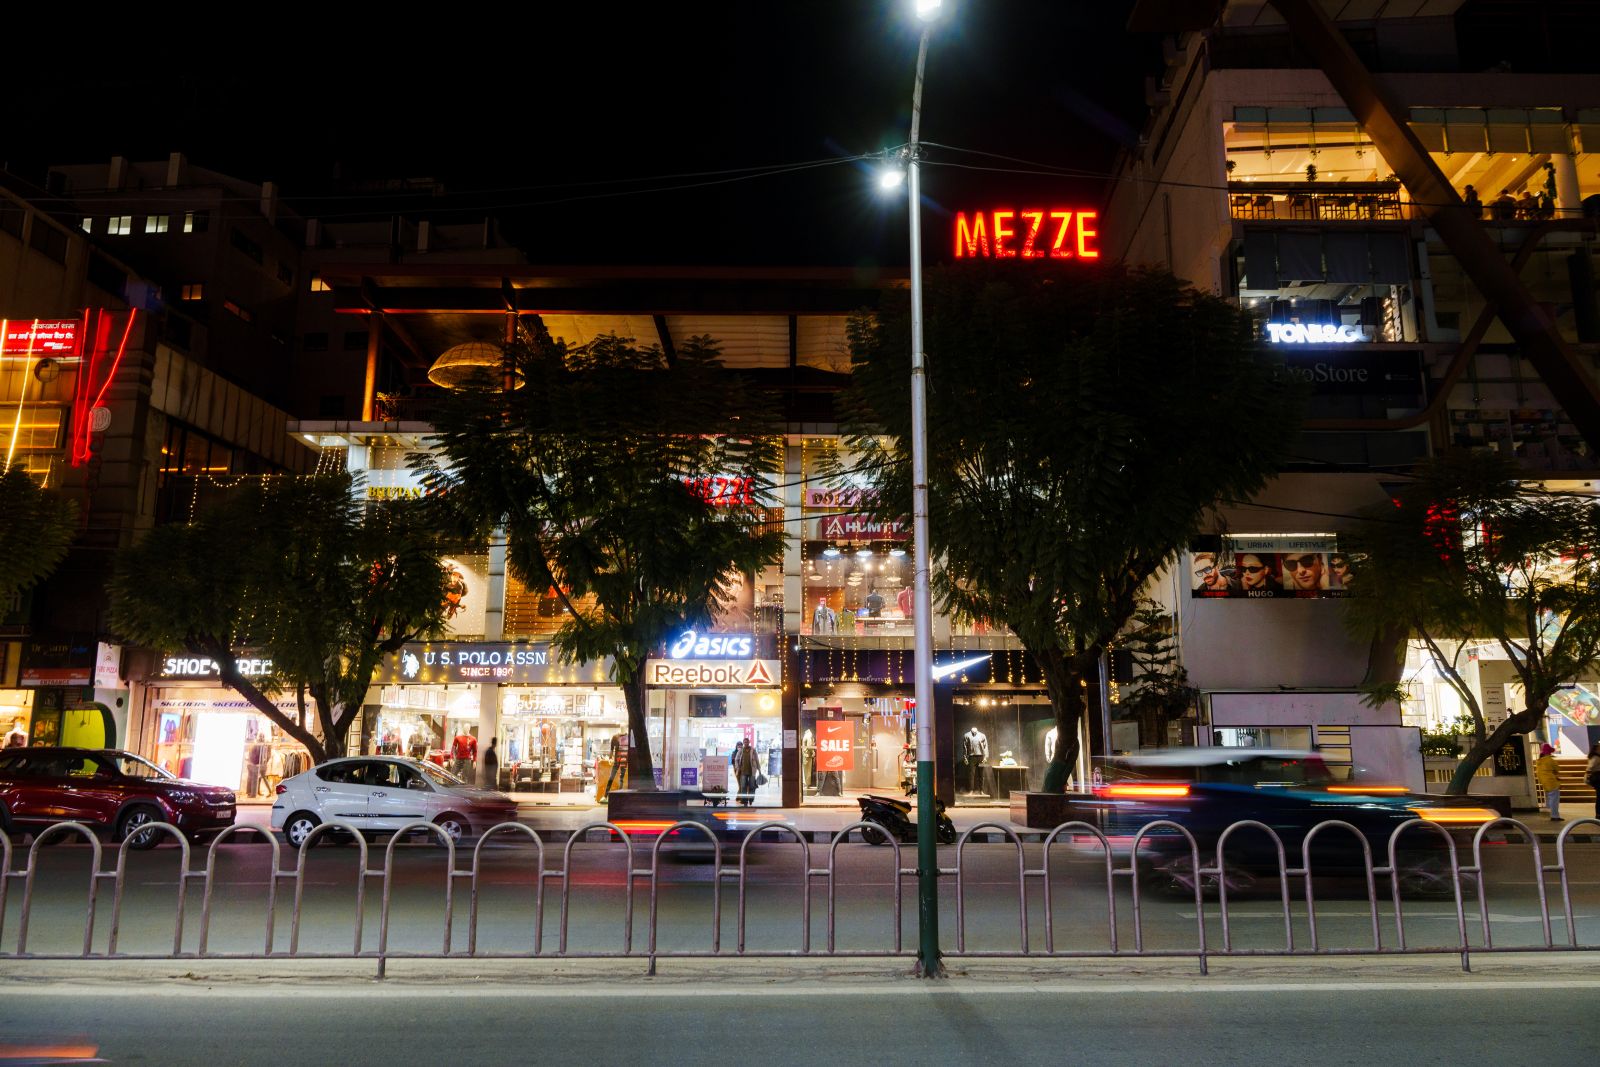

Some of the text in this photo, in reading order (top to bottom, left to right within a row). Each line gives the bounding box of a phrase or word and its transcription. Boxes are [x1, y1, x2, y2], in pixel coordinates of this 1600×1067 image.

[955, 211, 1099, 258] MEZZE
[1267, 323, 1372, 342] TONI&G
[368, 486, 422, 499] BHUTAN
[845, 521, 905, 533] HUMTT
[1247, 541, 1327, 549] URBAN LIFESTYLE
[1248, 590, 1275, 598] HUGO
[423, 651, 549, 665] U. S. POLO ASSN.
[164, 658, 273, 675] SHOE REE
[460, 667, 514, 677] SINCE 1890
[654, 663, 742, 684] Reebok
[820, 739, 850, 752] SALE
